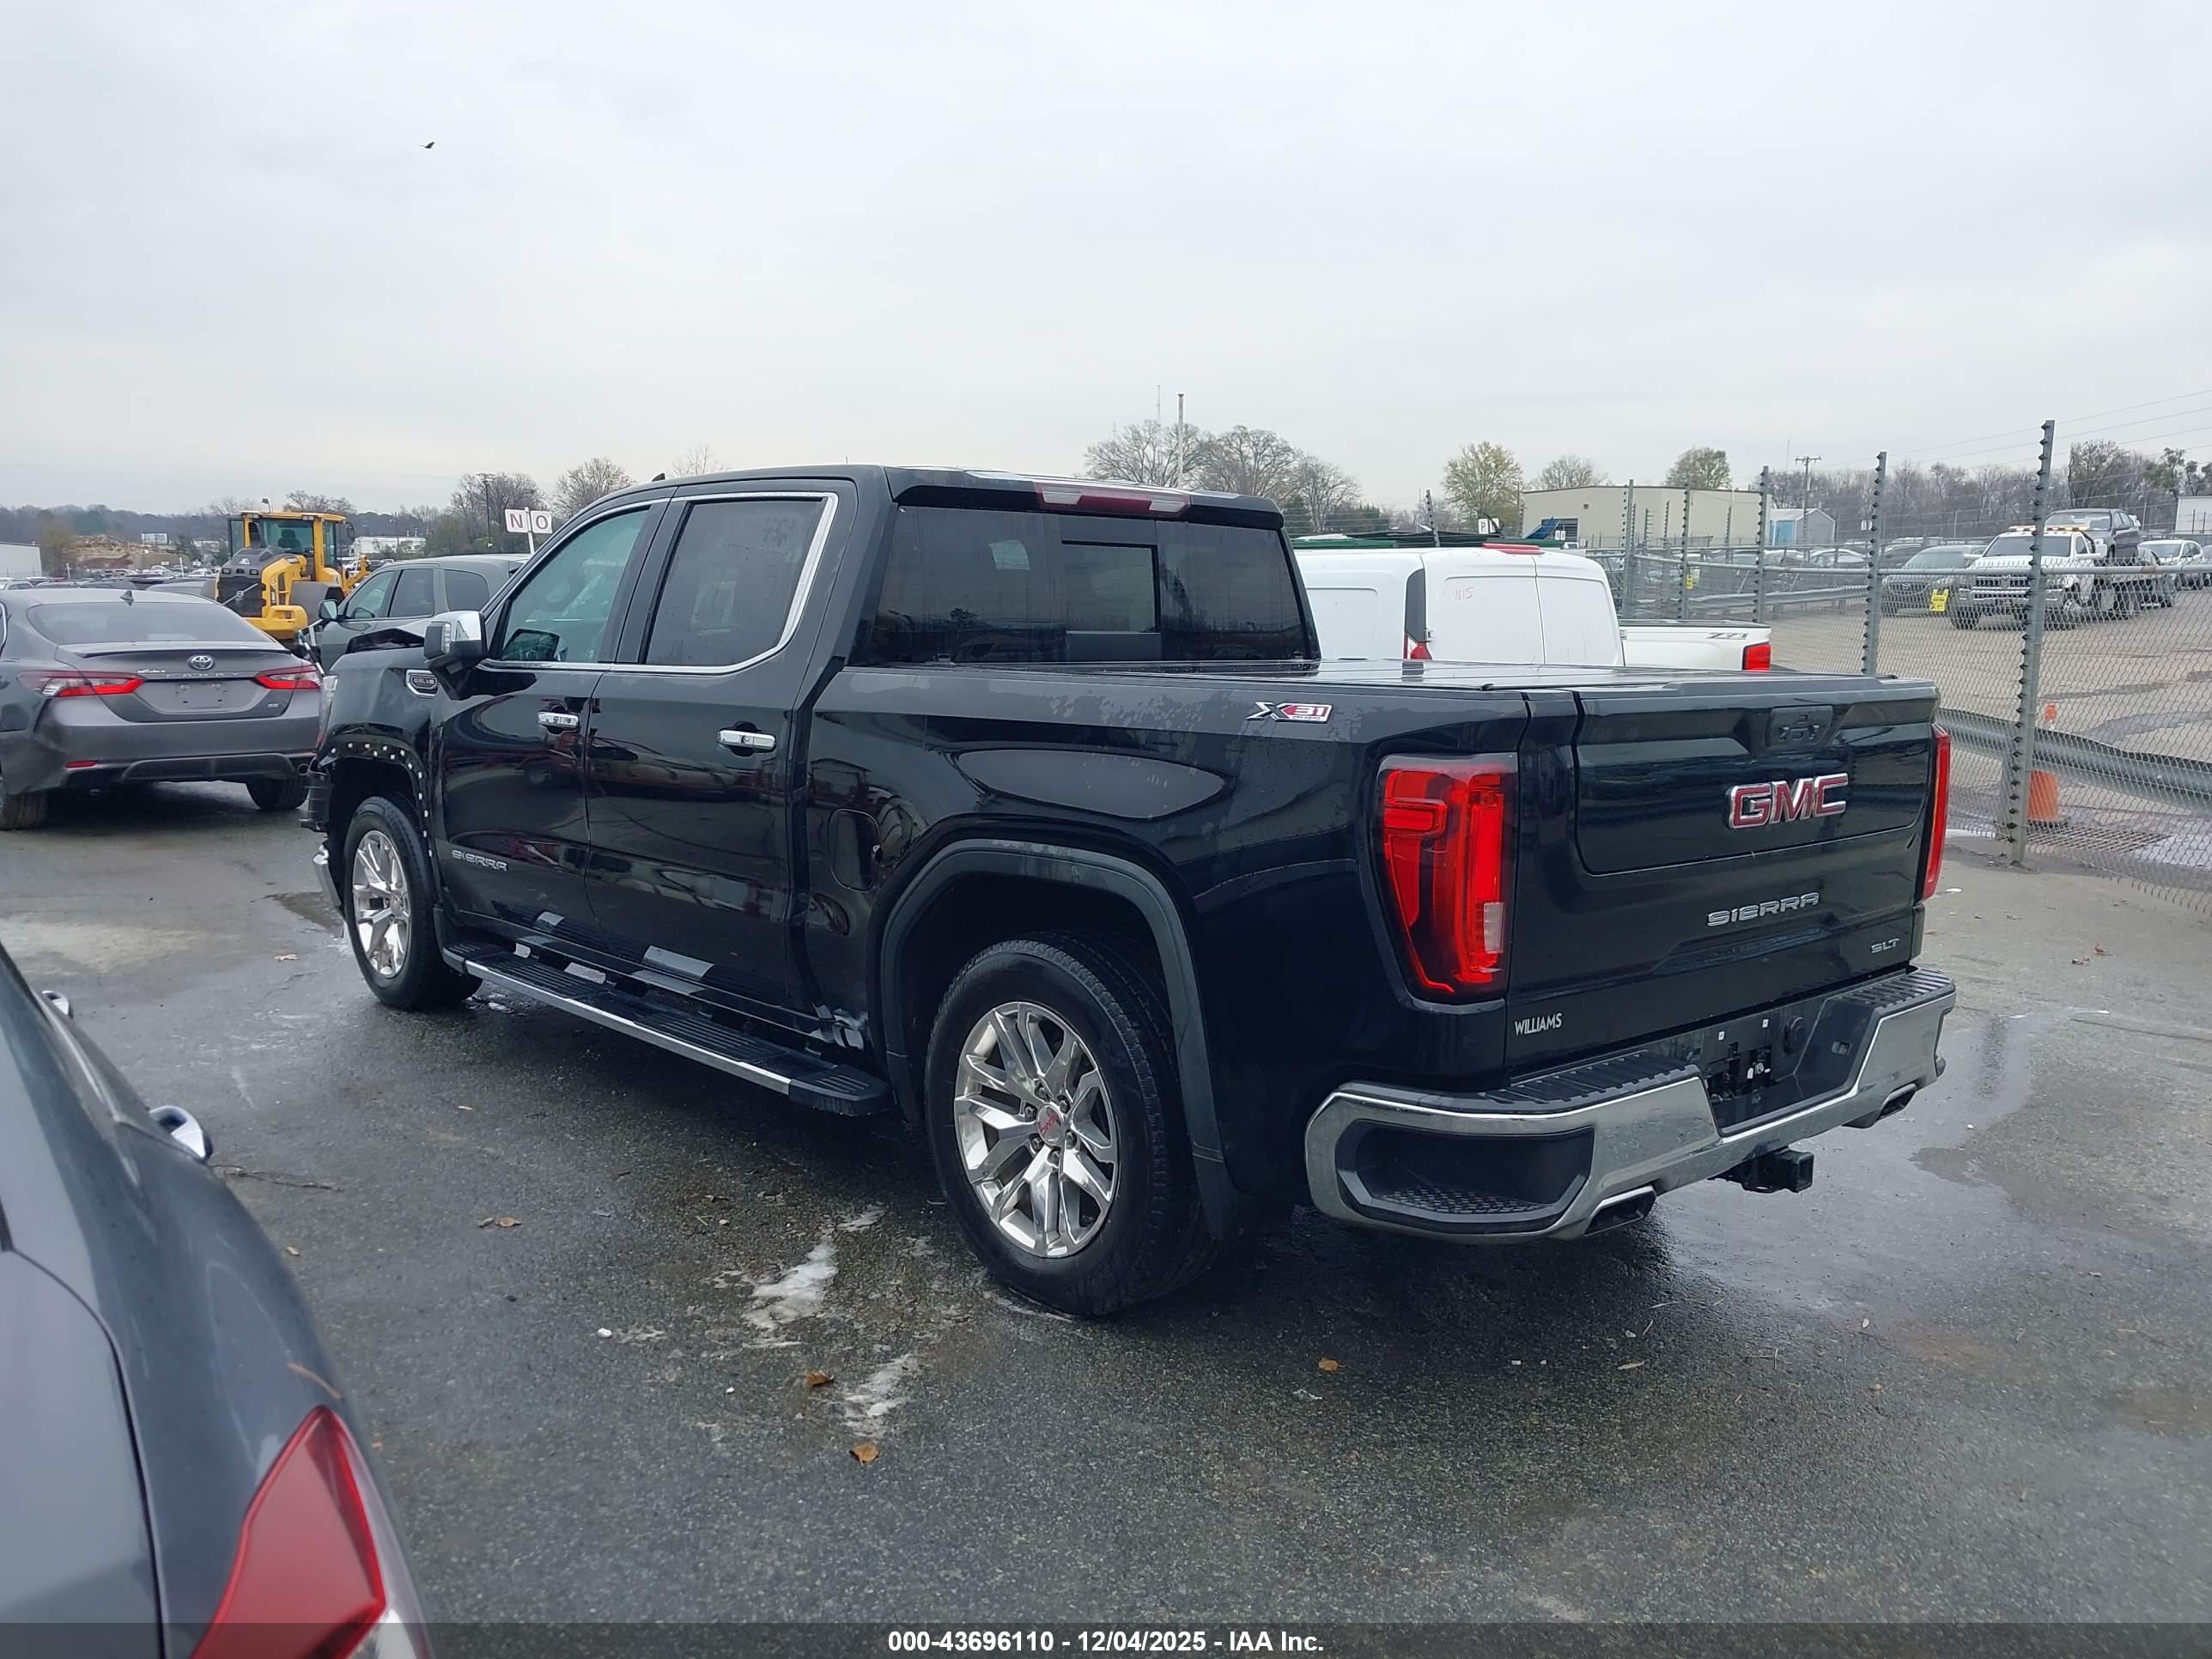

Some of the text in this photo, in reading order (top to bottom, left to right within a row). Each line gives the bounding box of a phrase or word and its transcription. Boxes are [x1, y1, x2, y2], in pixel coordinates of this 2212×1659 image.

[509, 513, 524, 529] N
[535, 514, 549, 530] O
[1245, 701, 1333, 722] X31
[1726, 772, 1849, 830] GMC
[452, 848, 508, 872] SIERRA
[1707, 891, 1820, 927] SIERRA
[1870, 938, 1900, 954] SLT
[1514, 1012, 1563, 1036] WILLIAMS
